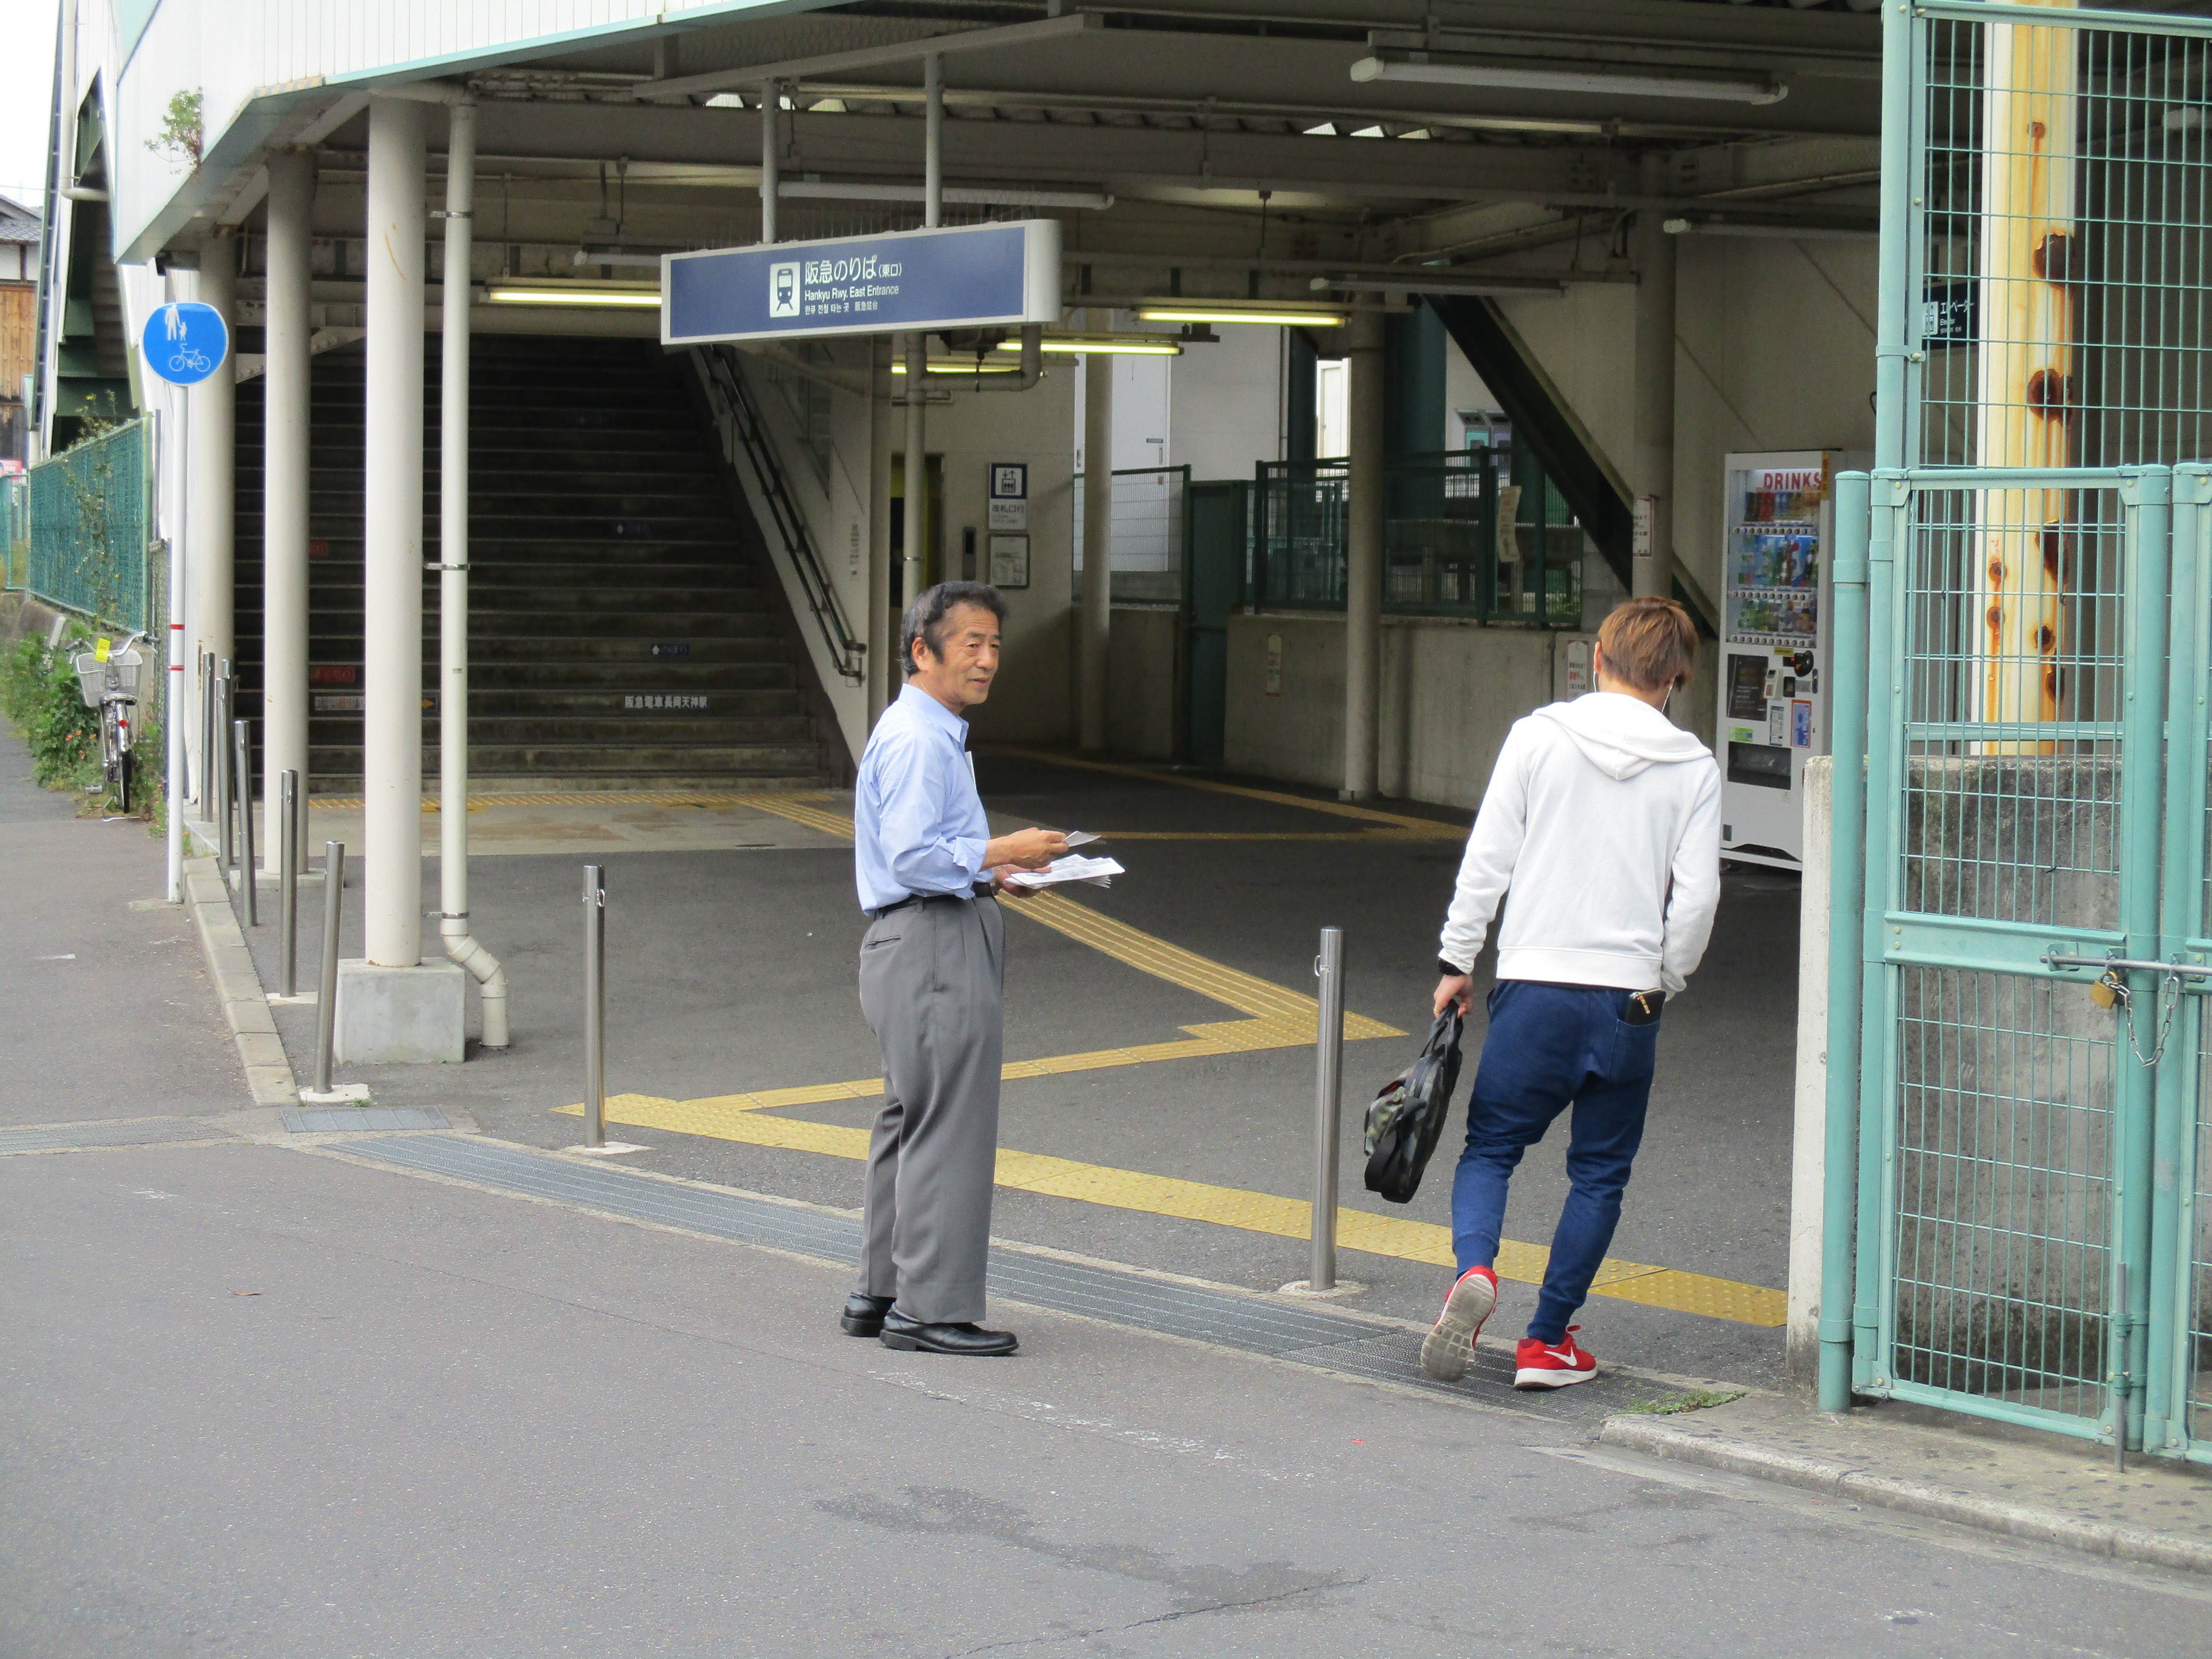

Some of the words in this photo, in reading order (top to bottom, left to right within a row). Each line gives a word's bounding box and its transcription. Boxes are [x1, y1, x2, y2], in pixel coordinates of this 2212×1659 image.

[805, 289, 830, 302] Hankyu
[832, 288, 848, 301] Rwy.
[850, 286, 866, 298] East
[867, 285, 899, 296] Entrance
[1764, 472, 1822, 490] DRINKS
